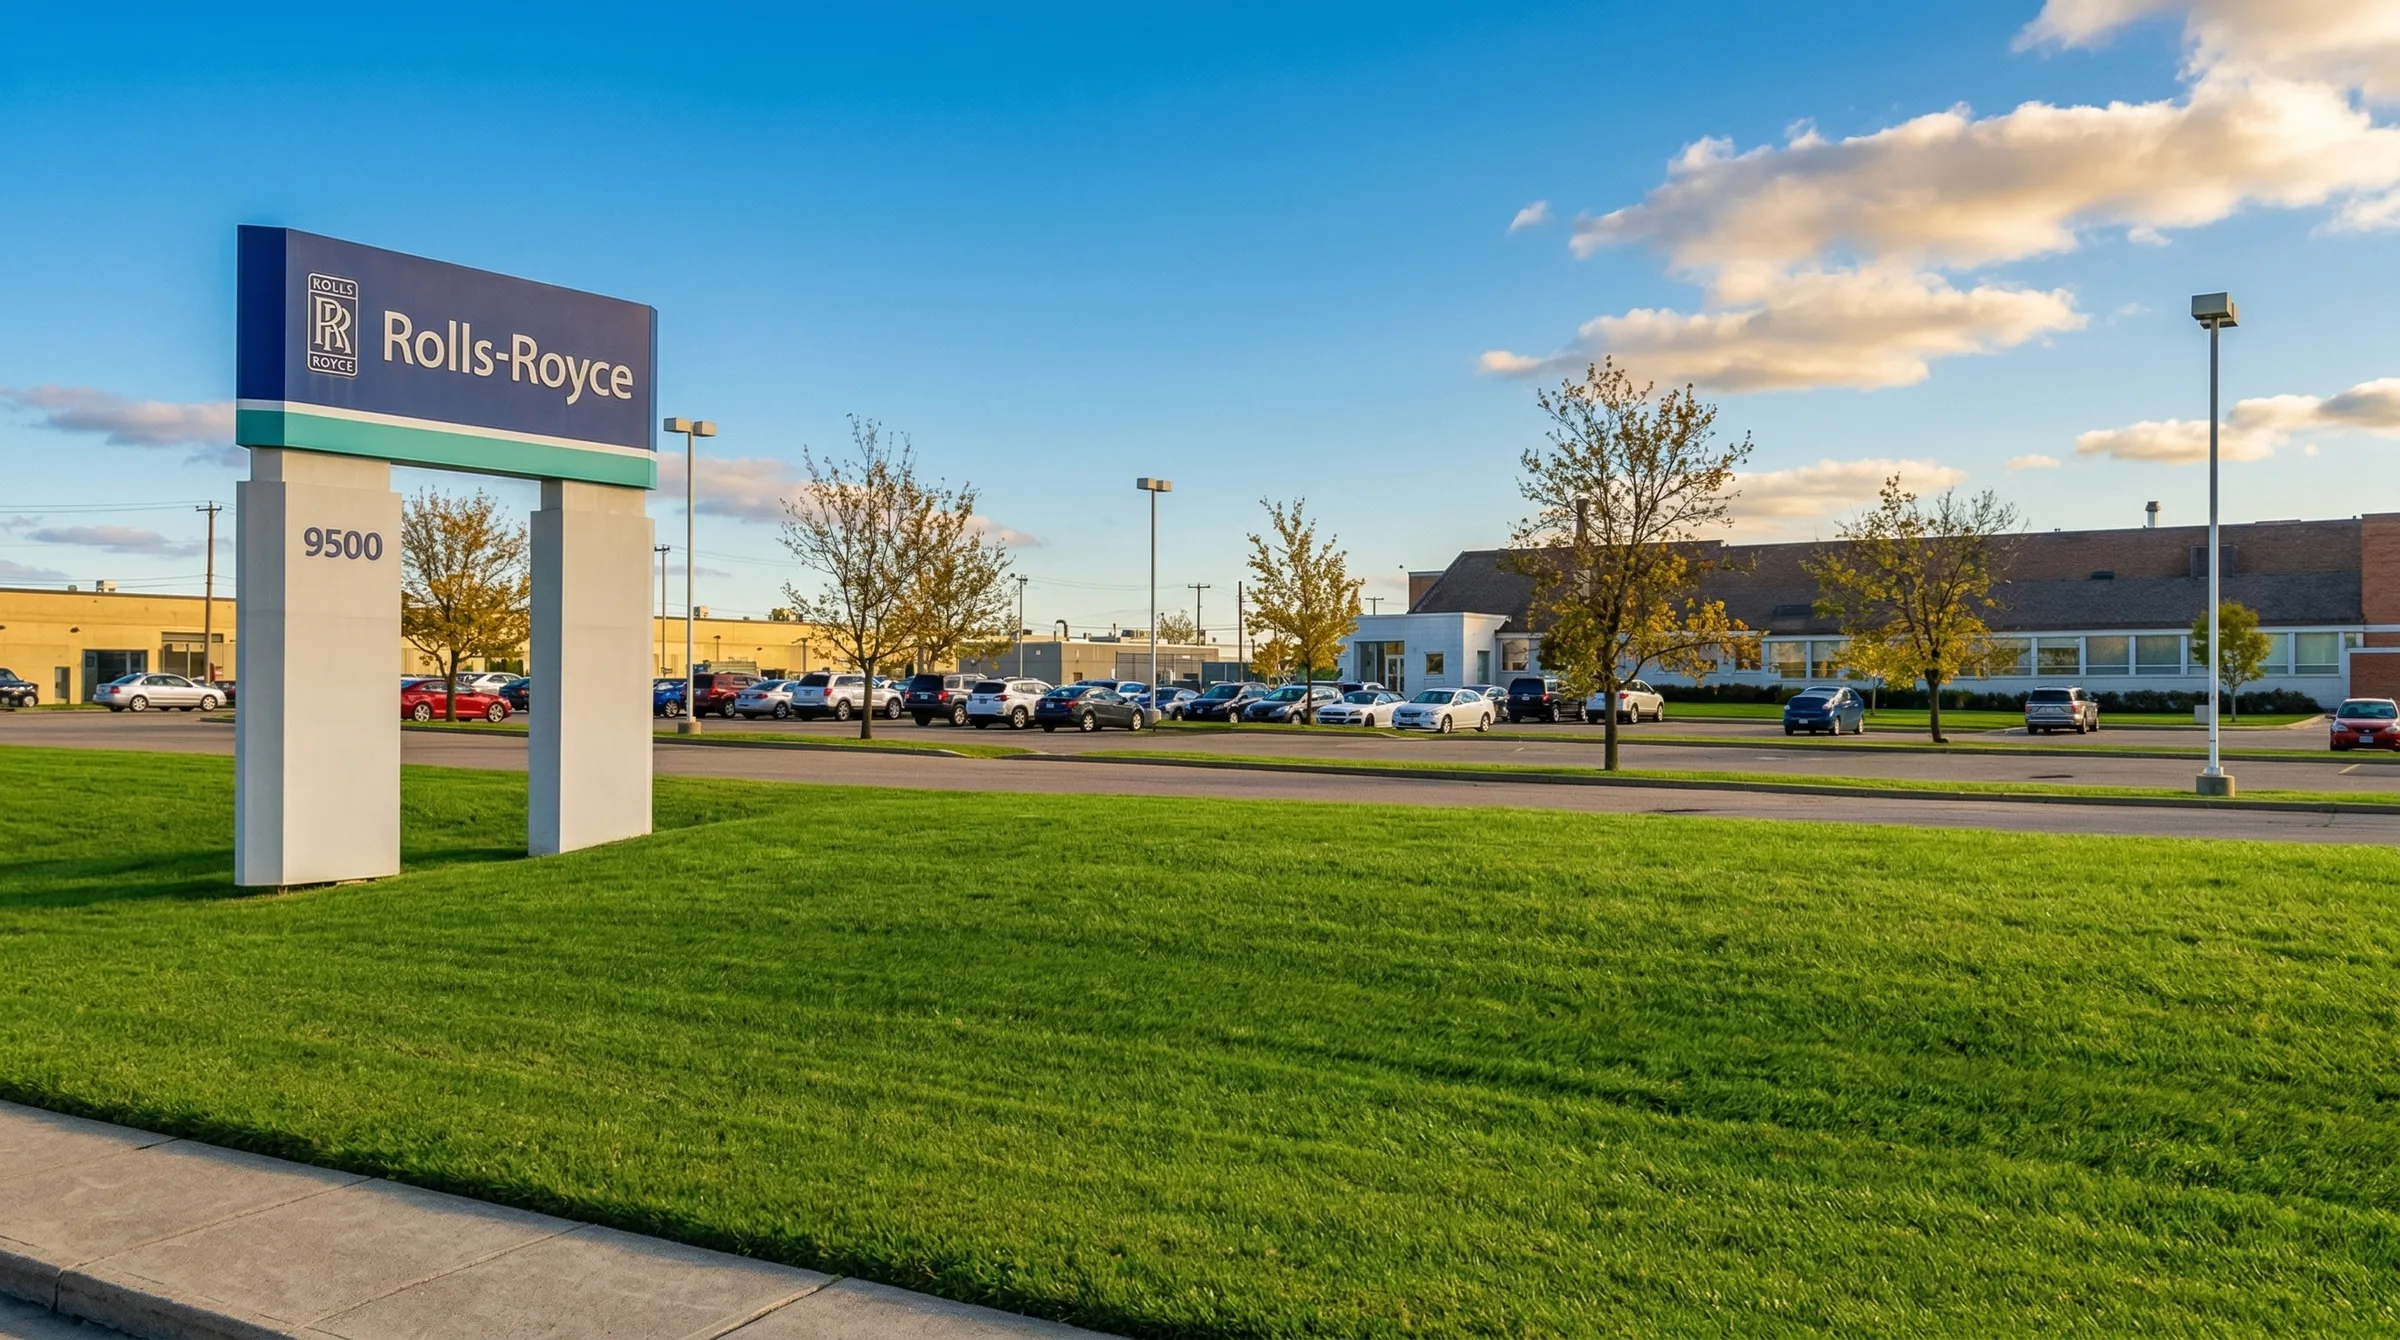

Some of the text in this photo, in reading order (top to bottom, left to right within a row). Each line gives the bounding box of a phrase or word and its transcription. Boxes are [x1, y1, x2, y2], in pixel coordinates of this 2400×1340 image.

[313, 277, 353, 295] ROLLS
[314, 296, 352, 354] RR
[312, 356, 353, 372] ROYCE
[383, 310, 633, 405] Rolls-Royce
[303, 526, 383, 560] 9500
